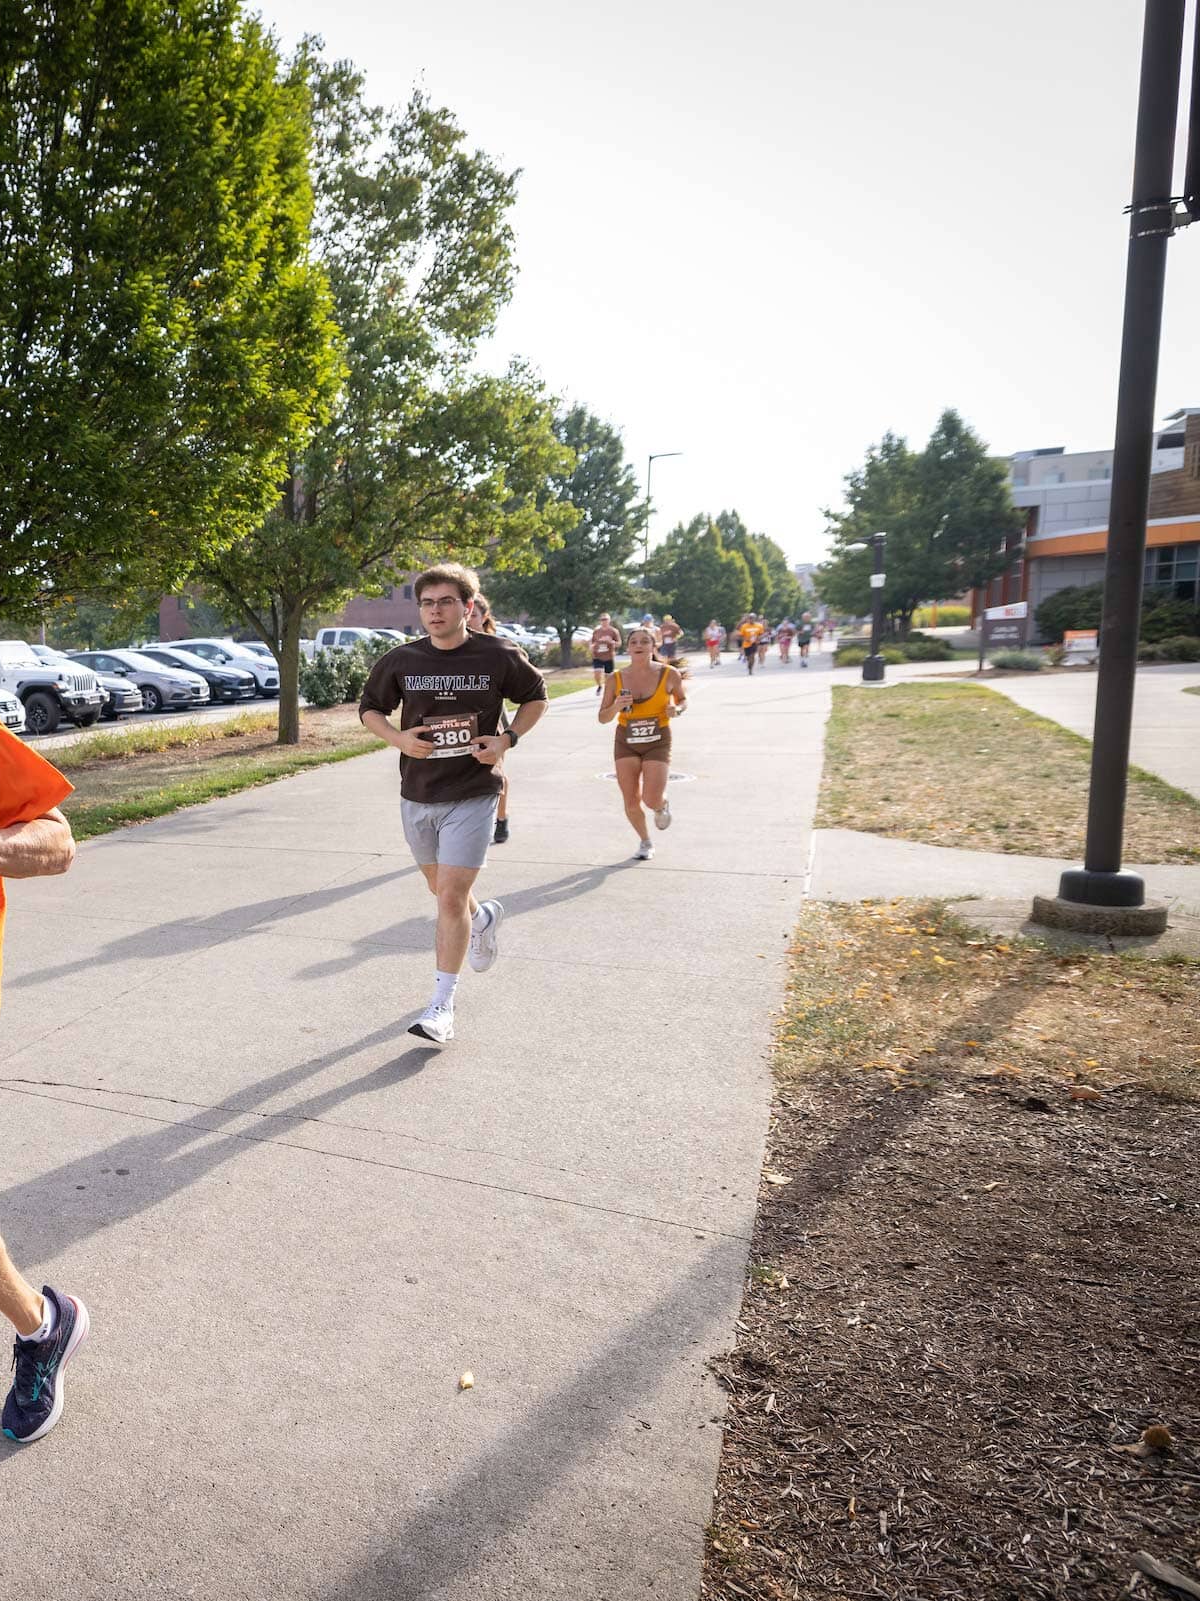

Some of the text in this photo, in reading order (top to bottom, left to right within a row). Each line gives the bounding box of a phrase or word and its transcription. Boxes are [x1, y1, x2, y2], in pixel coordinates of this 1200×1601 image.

[404, 675, 490, 691] NASHVILLE
[432, 729, 471, 746] 380
[632, 726, 656, 736] 327
